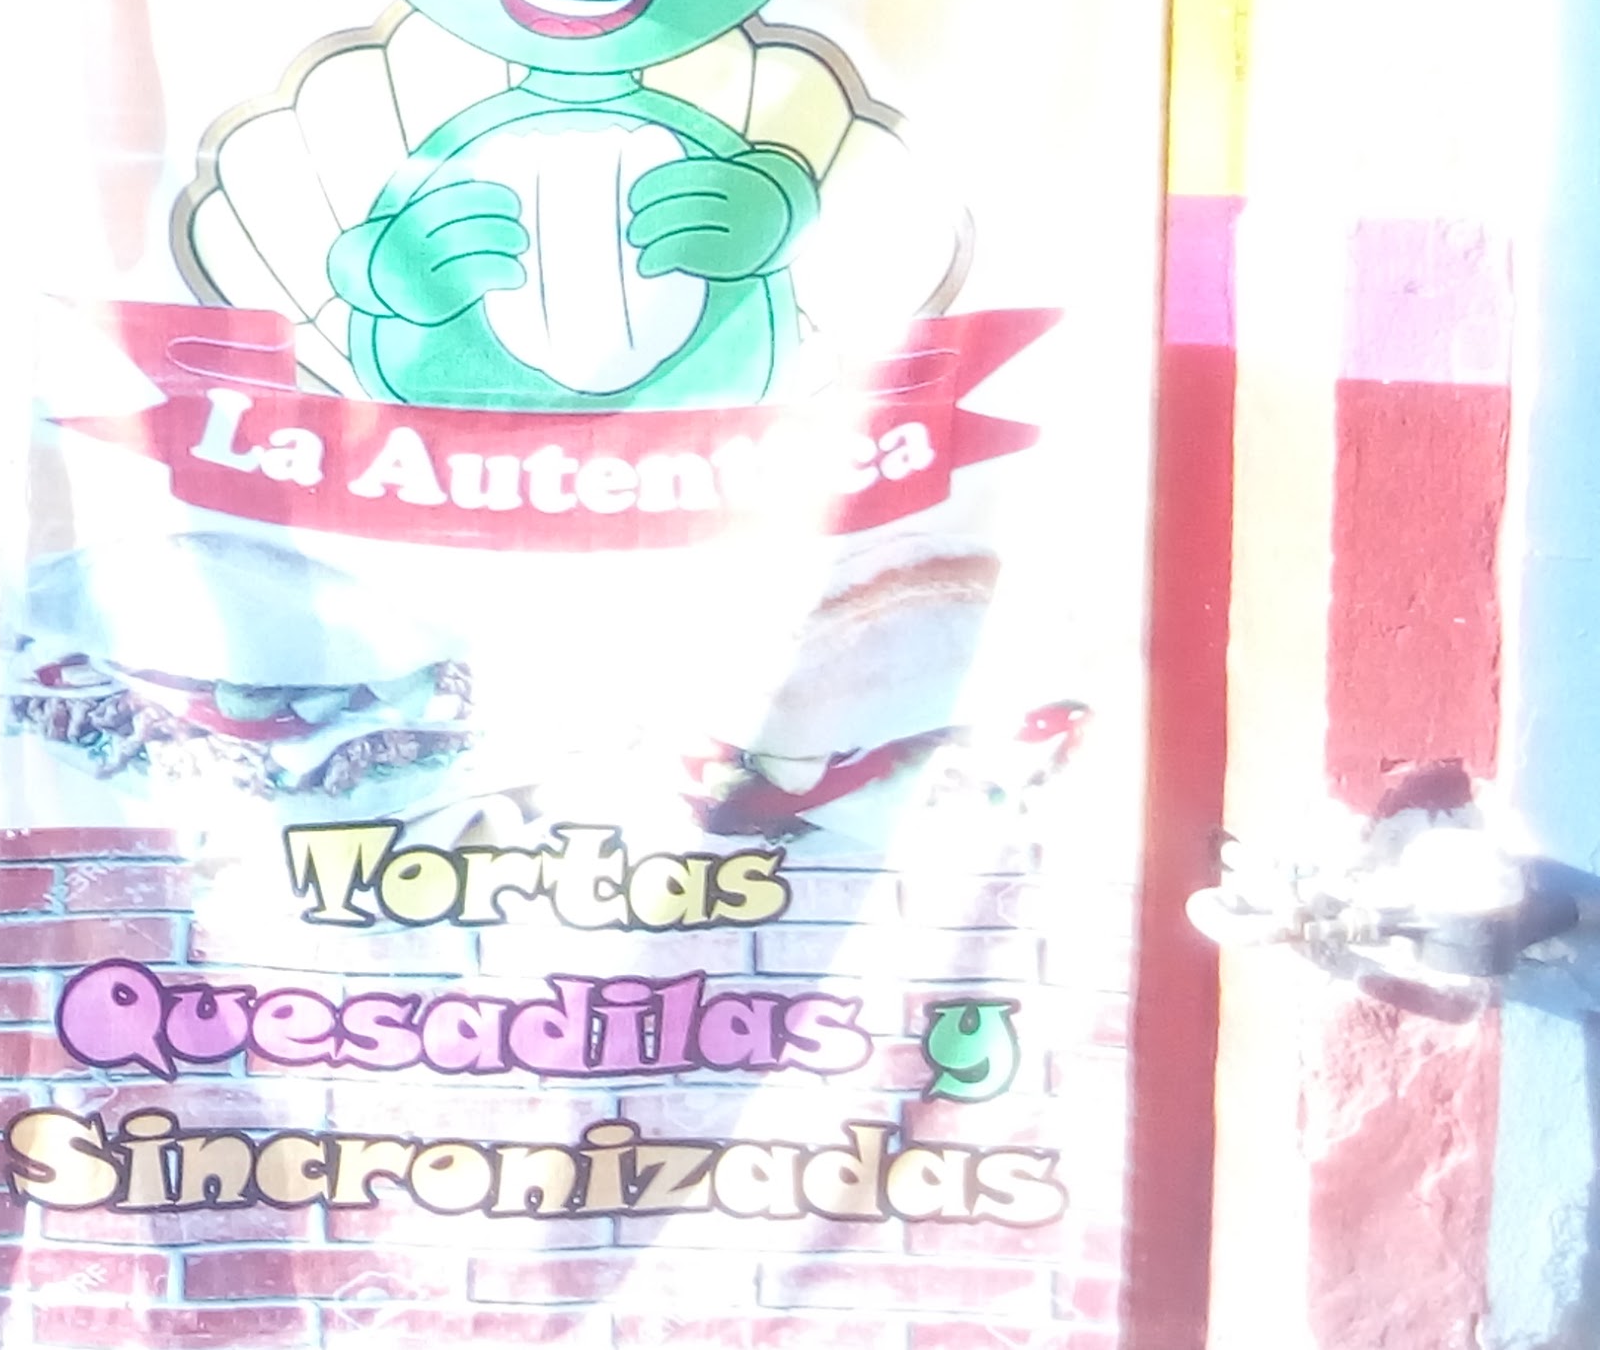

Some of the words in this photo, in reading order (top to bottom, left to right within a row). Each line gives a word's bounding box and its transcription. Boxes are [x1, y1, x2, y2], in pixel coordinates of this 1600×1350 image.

[190, 388, 323, 486] La
[347, 420, 936, 514] Autenca
[284, 822, 793, 929] Tortas
[56, 958, 874, 1082] Quesadilas
[920, 996, 1022, 1102] y
[4, 1106, 1070, 1226] Sincronizadas
